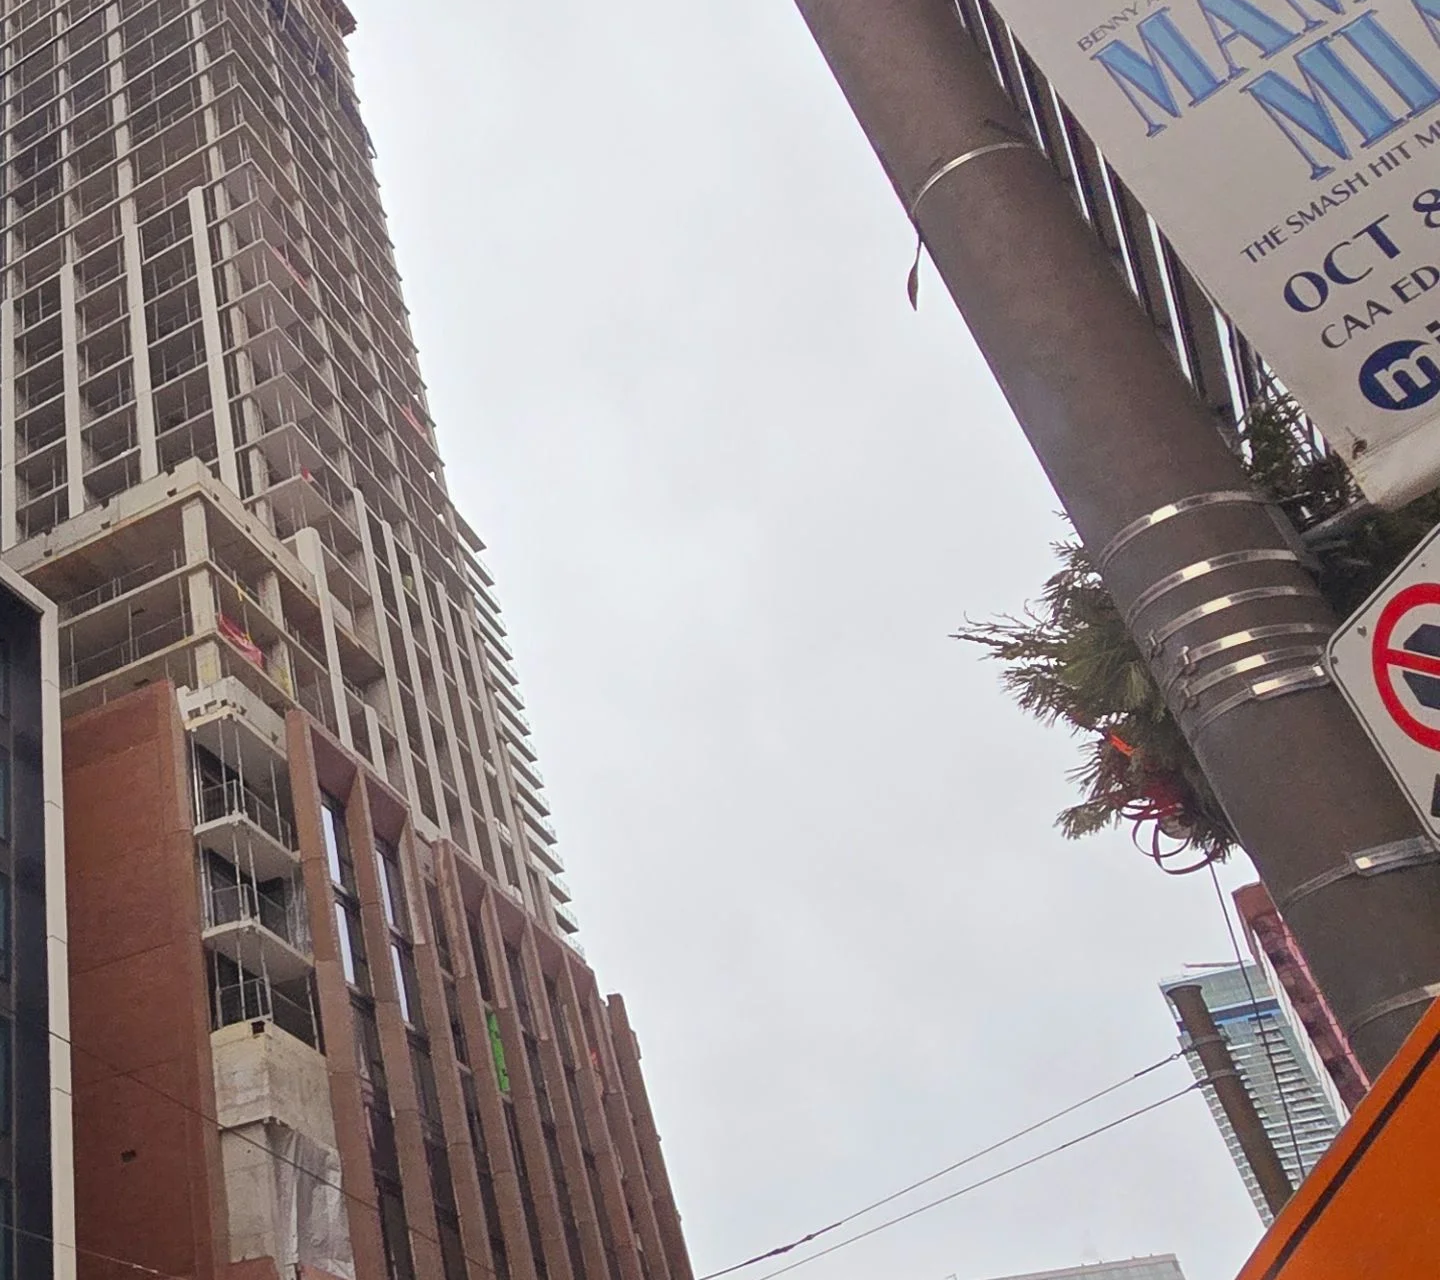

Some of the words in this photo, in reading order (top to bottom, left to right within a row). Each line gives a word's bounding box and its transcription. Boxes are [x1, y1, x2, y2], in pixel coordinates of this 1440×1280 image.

[1076, 1, 1141, 52] BENNY
[1240, 226, 1289, 264] THE
[1286, 172, 1370, 235] SMASH
[1368, 140, 1412, 178] HIT
[1283, 214, 1402, 313] OCT
[1321, 299, 1393, 349] CAA
